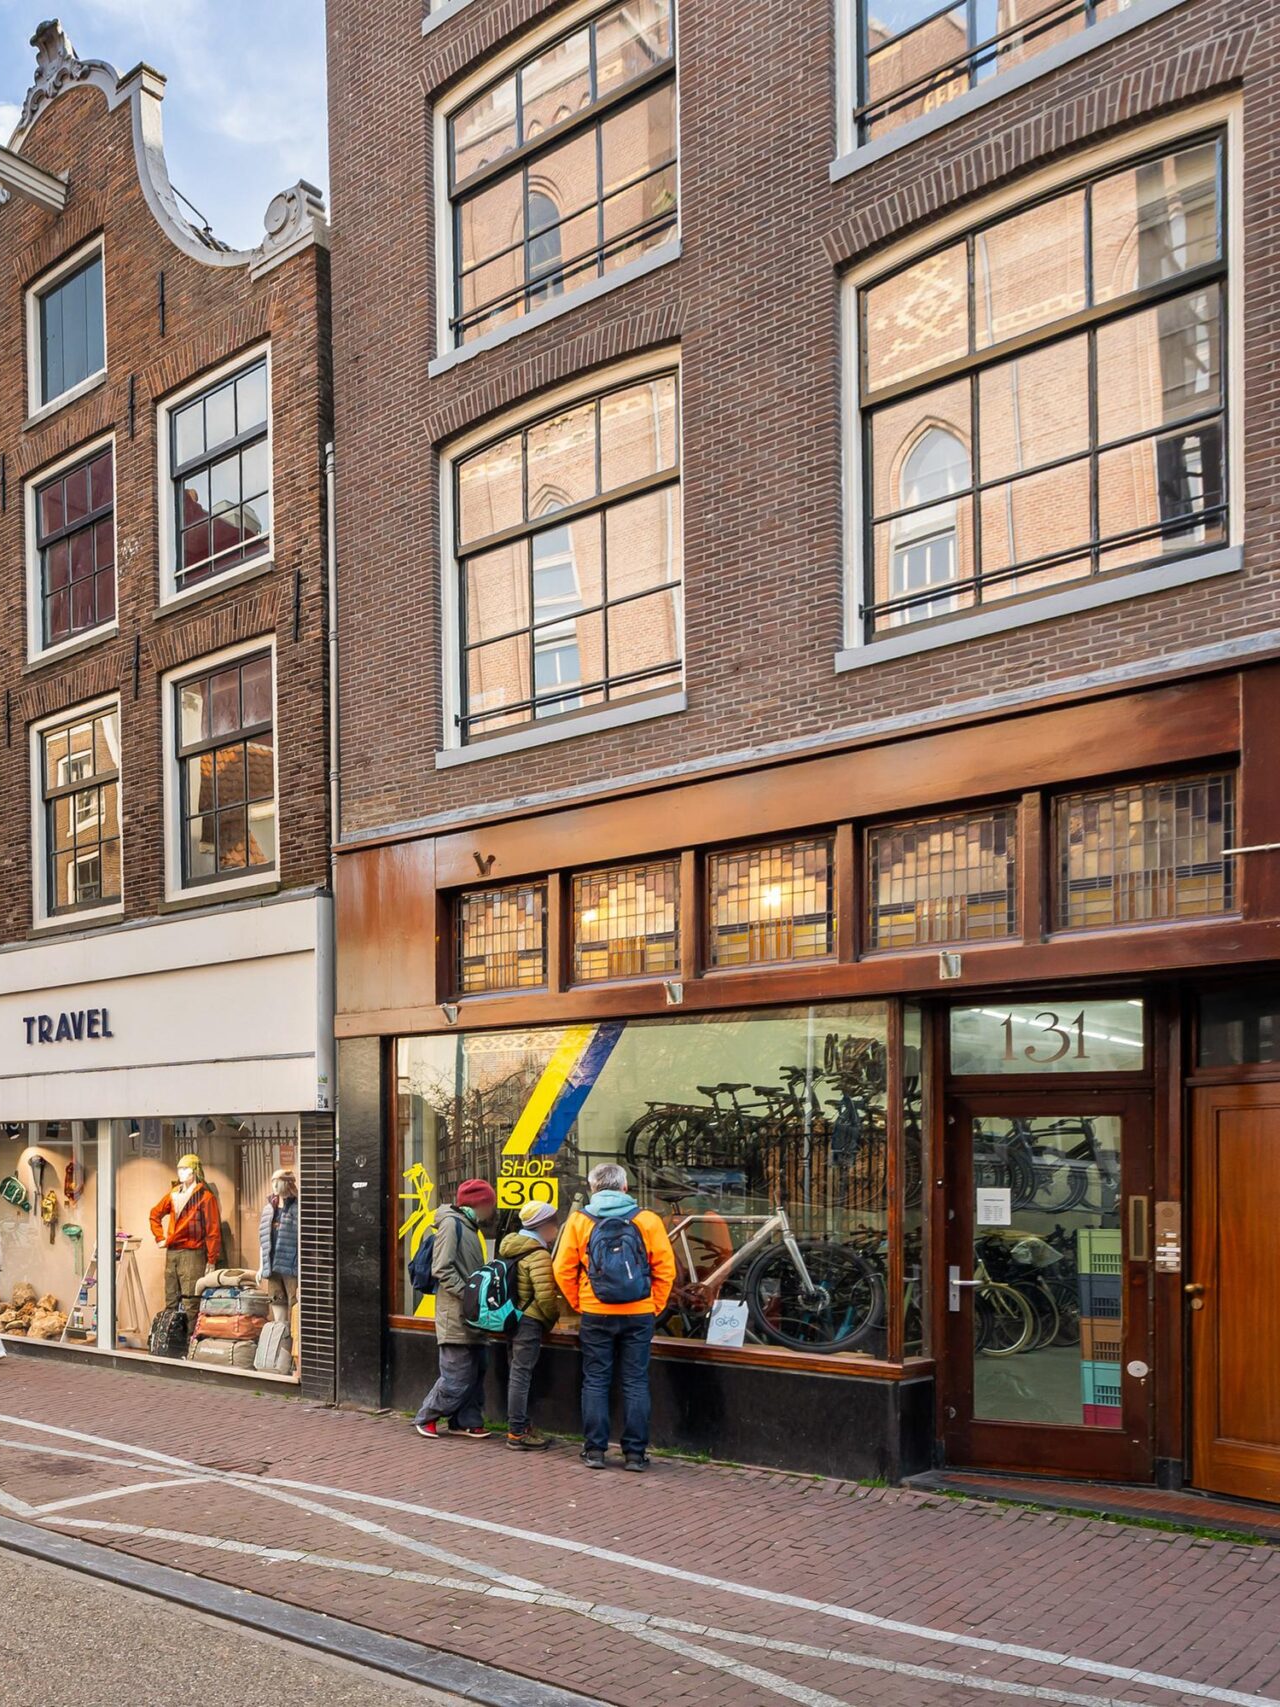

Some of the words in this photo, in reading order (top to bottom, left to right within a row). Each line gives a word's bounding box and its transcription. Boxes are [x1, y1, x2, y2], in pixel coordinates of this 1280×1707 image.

[22, 1008, 114, 1045] TRAVEL
[1000, 1010, 1090, 1064] 131
[500, 1159, 555, 1177] SHOP
[501, 1180, 554, 1206] 30
